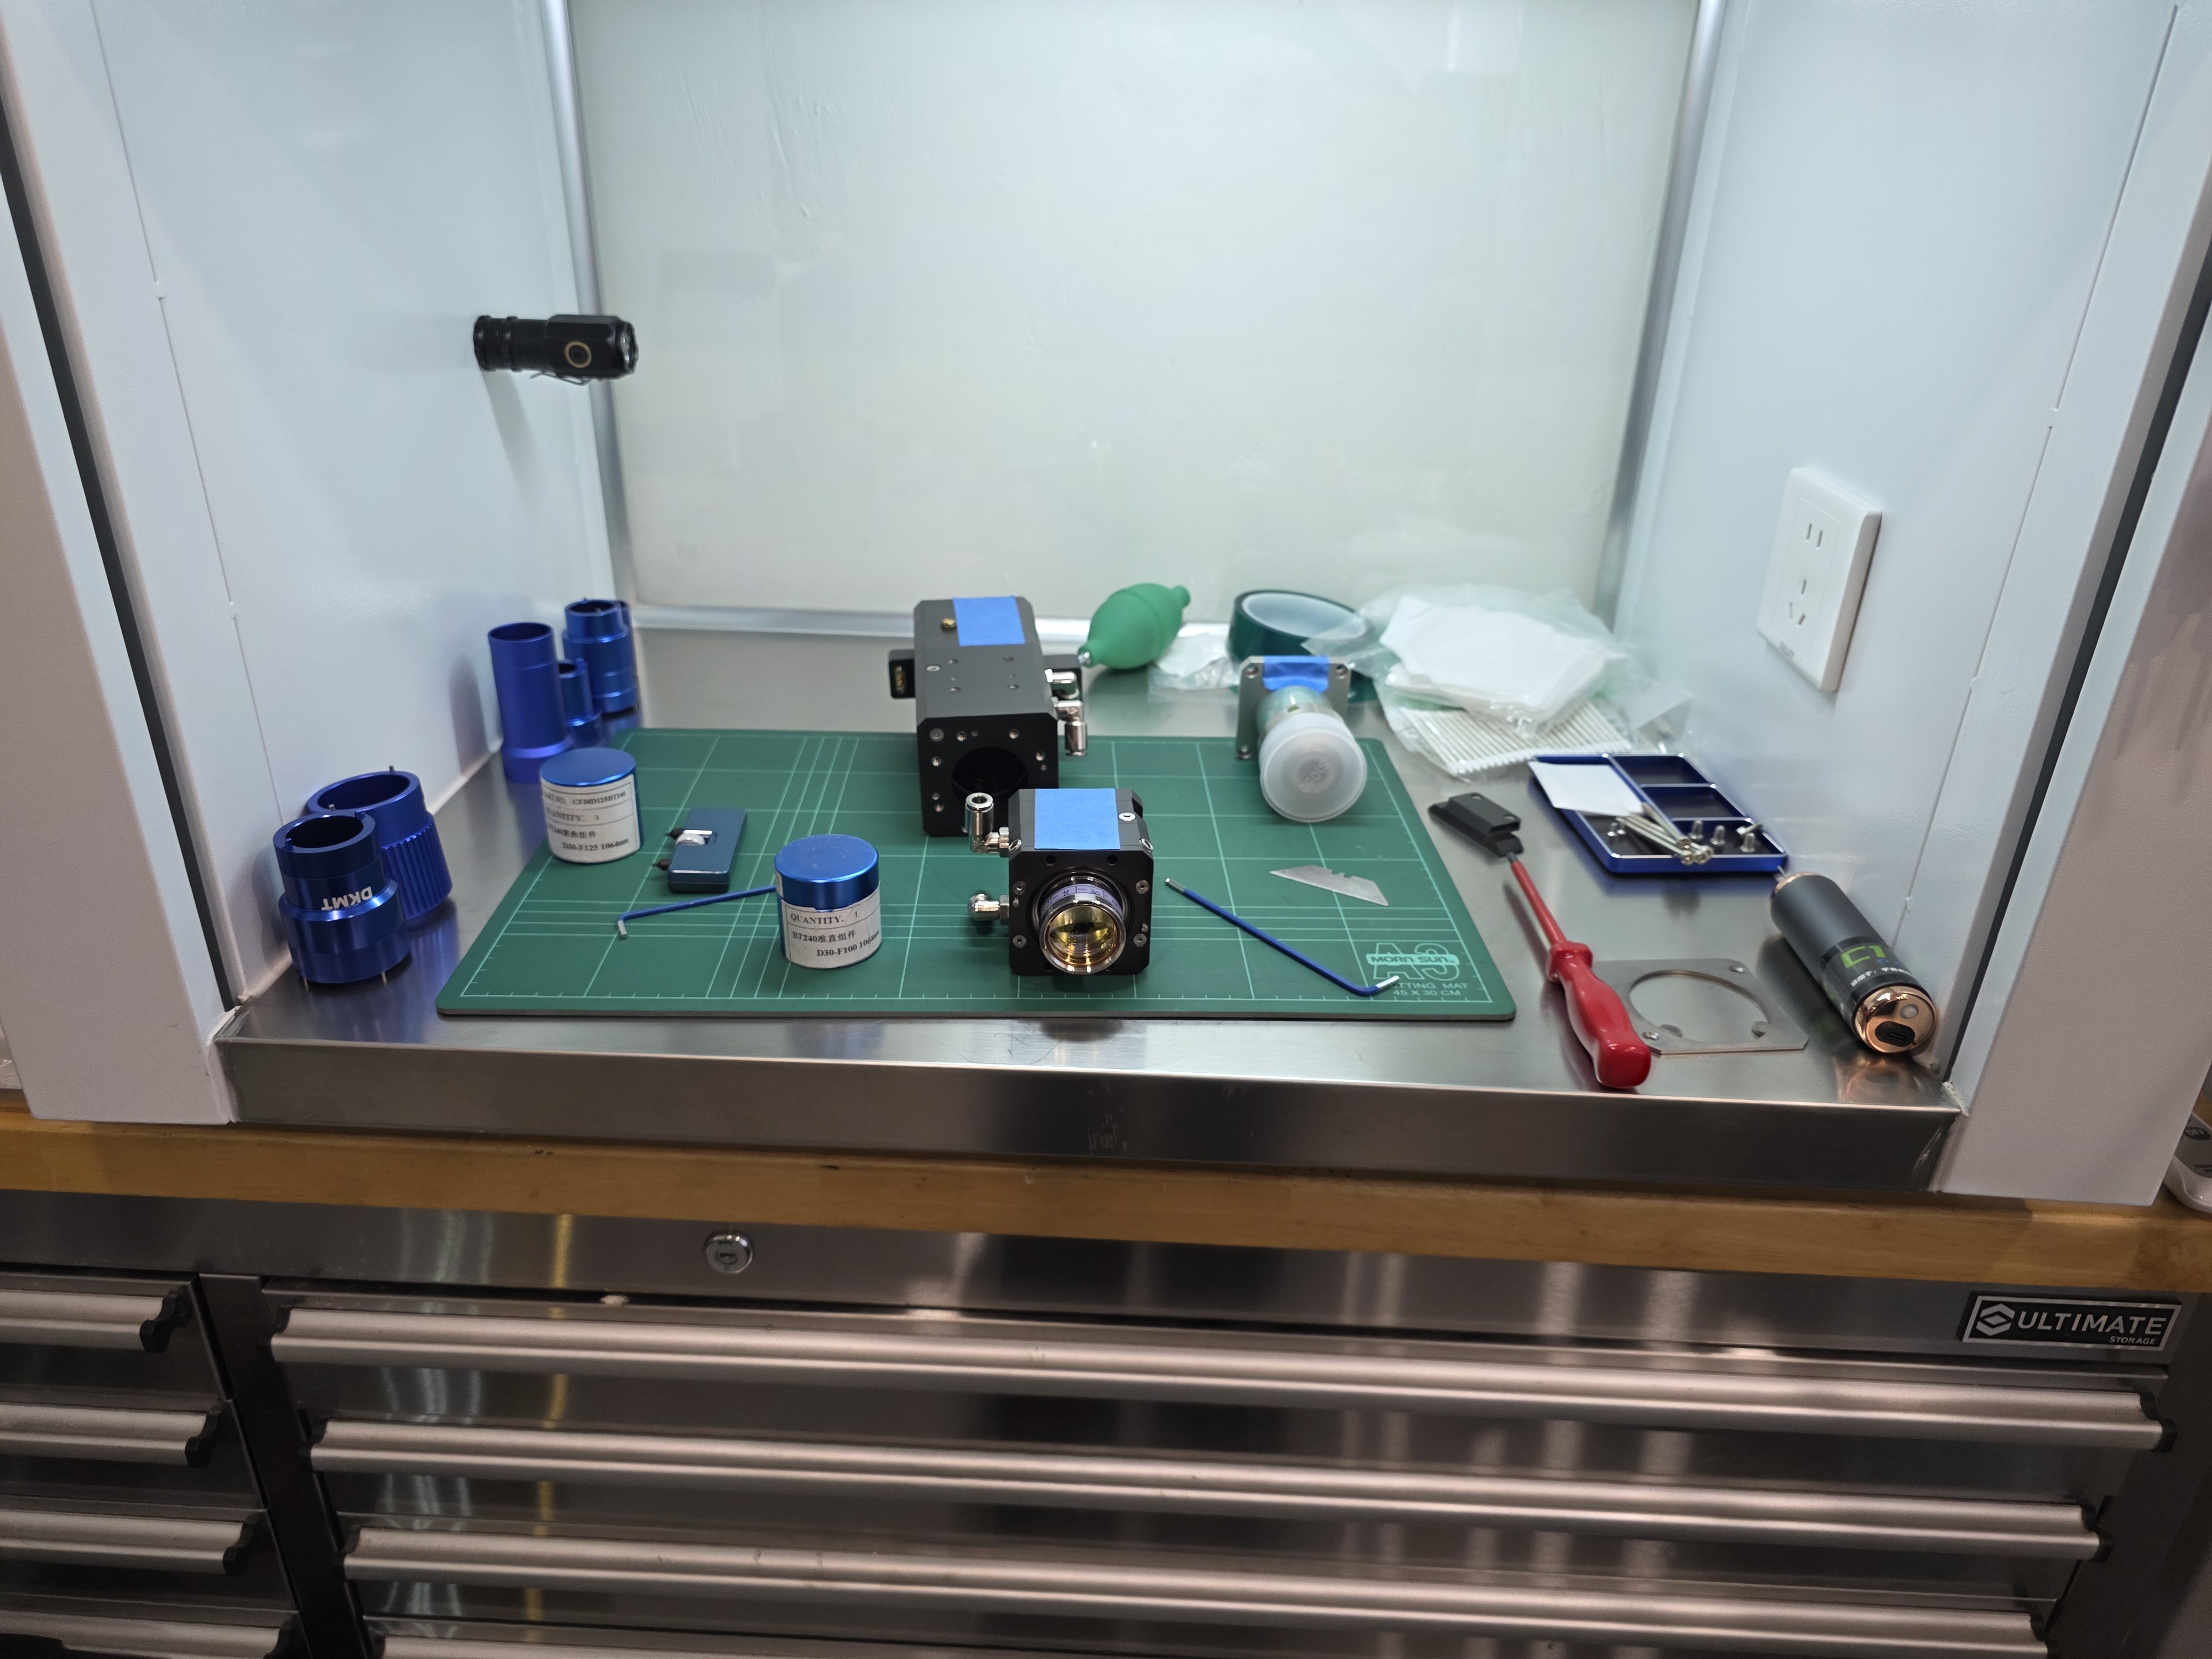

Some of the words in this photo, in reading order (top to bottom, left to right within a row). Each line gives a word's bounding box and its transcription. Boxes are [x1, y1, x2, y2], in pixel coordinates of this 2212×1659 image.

[321, 886, 374, 911] DKMT
[816, 943, 858, 957] D30-F100
[2017, 1311, 2167, 1335] ULTIMATE
[2109, 1335, 2157, 1345] STORAGE
